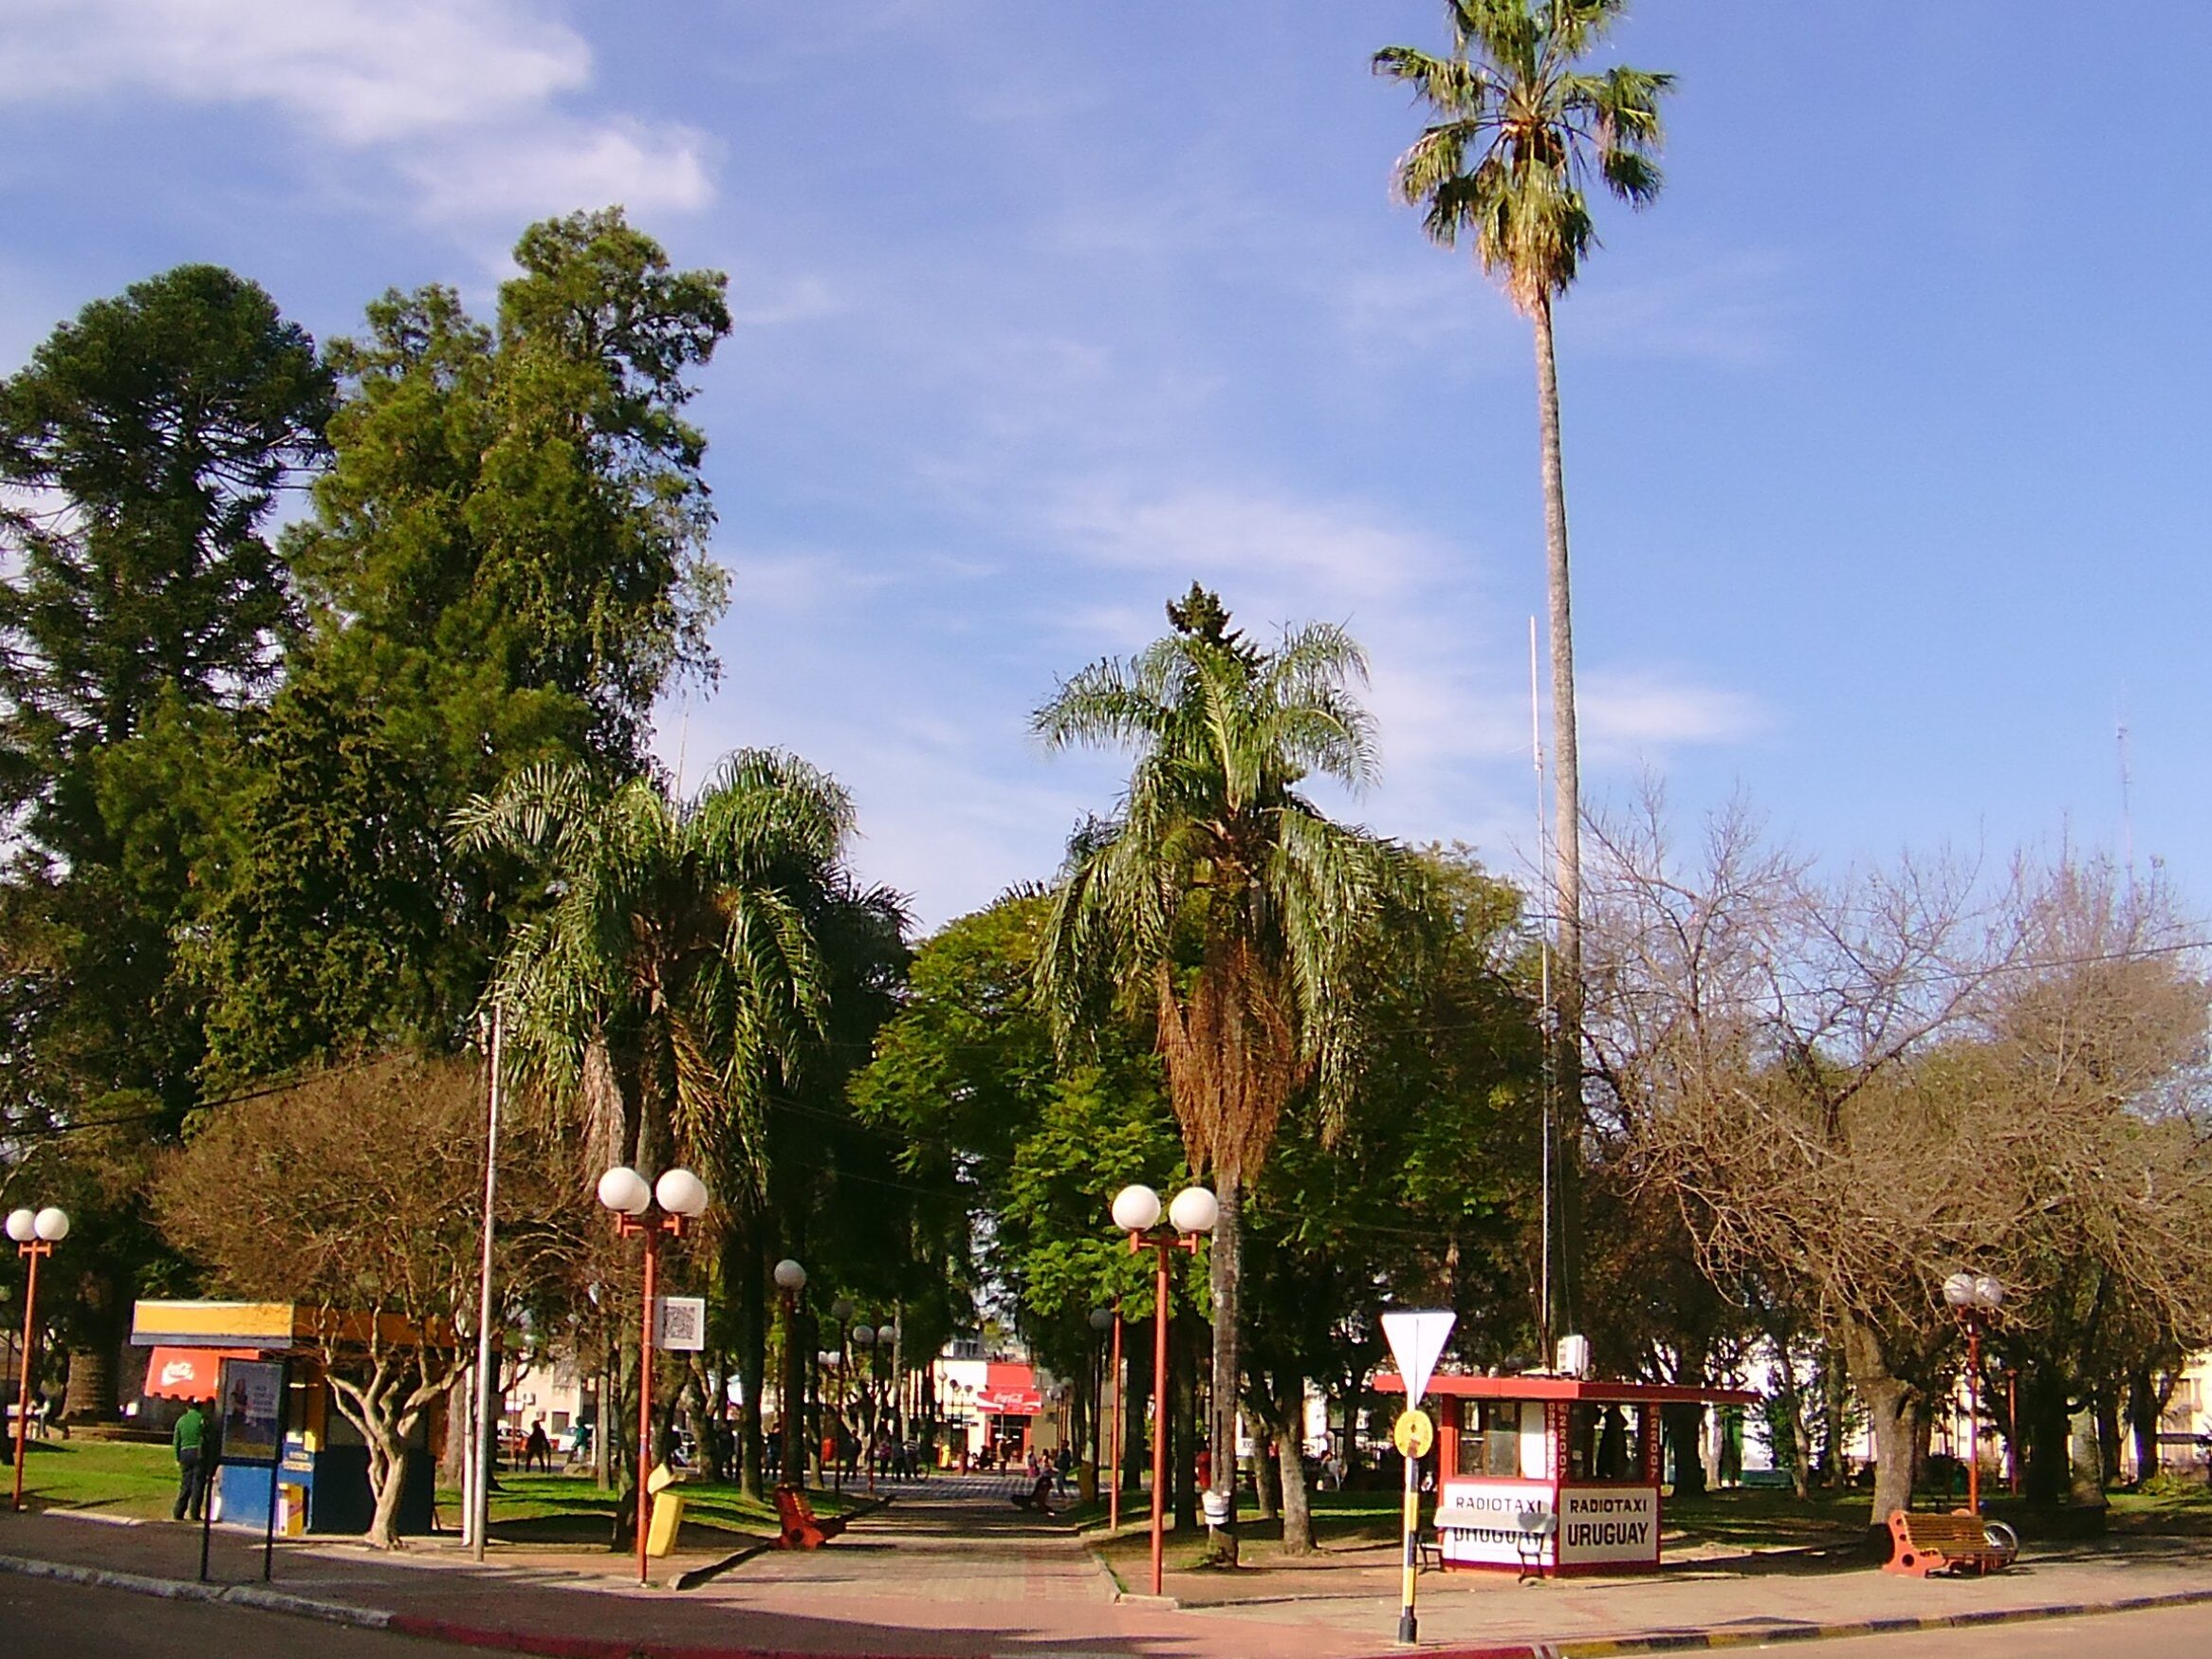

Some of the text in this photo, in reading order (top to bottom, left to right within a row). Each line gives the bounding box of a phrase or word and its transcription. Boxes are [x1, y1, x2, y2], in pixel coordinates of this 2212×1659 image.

[1558, 1414, 1567, 1479] 22007
[1456, 1497, 1542, 1514] RADIOTAXI
[1571, 1500, 1648, 1514] RADIOTAXI
[1568, 1522, 1650, 1546] URUGUAY
